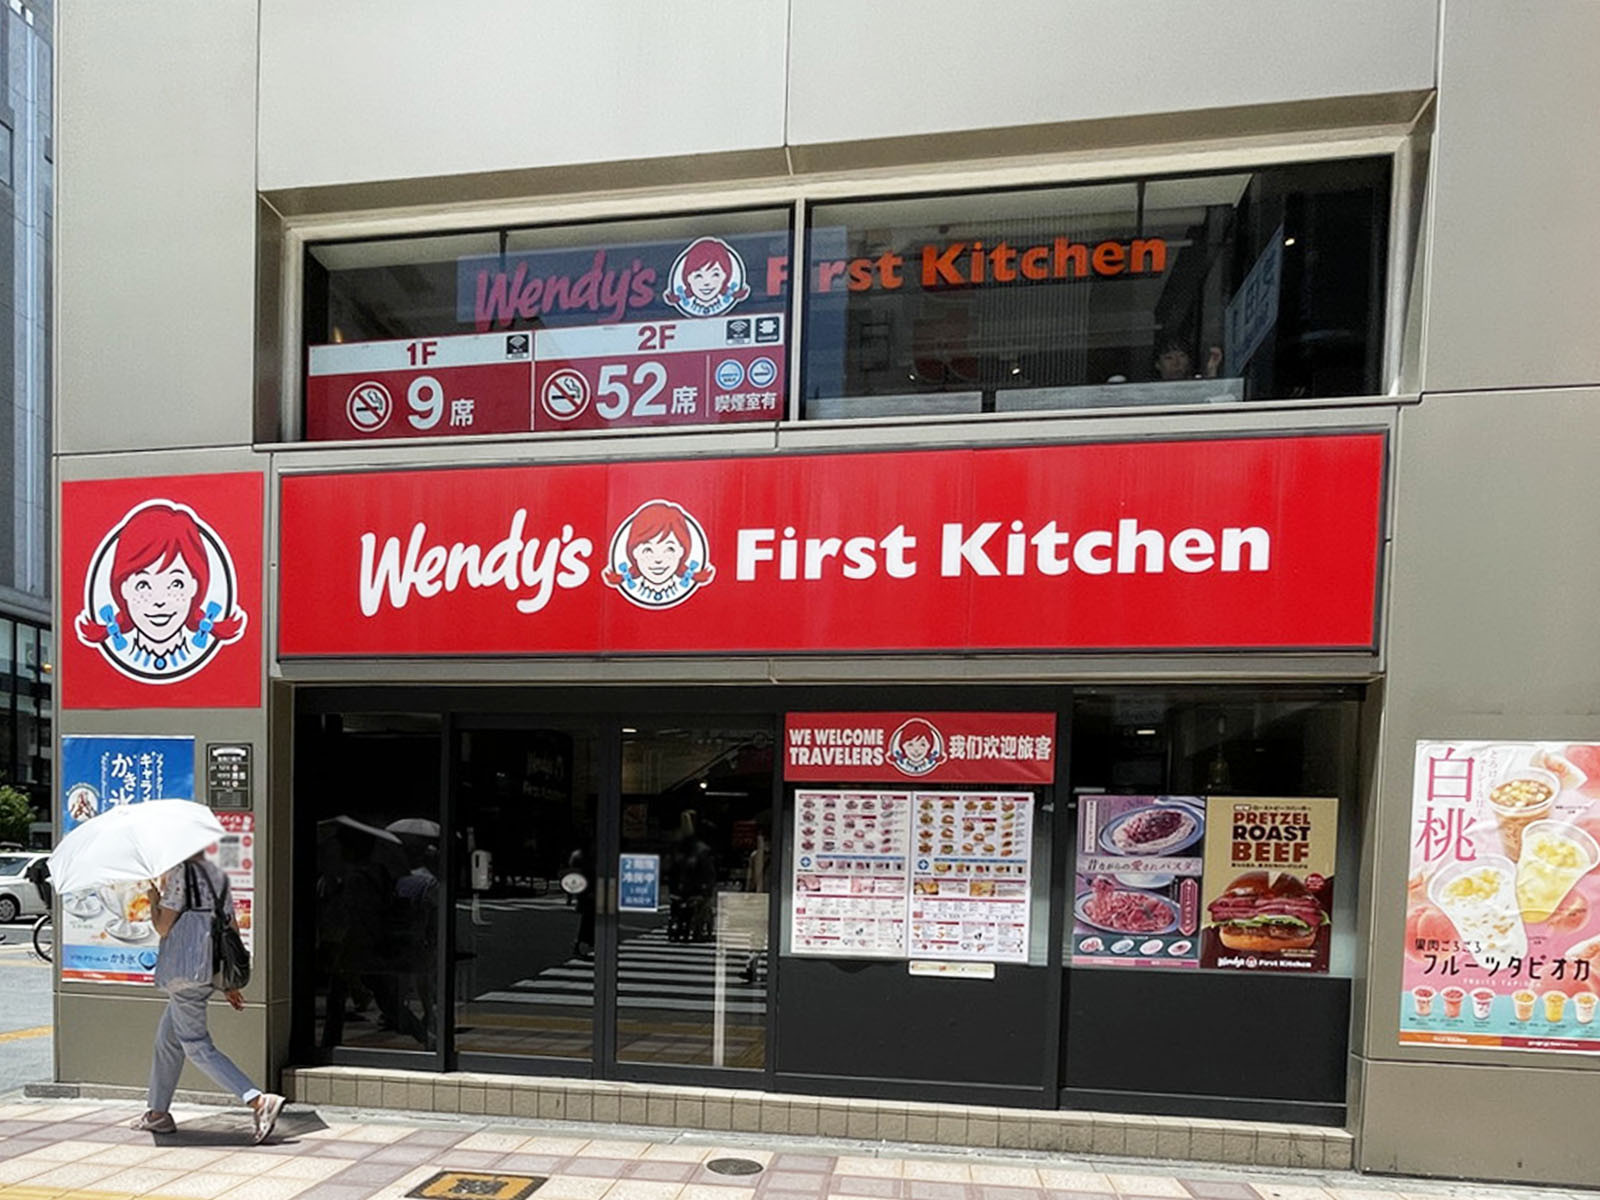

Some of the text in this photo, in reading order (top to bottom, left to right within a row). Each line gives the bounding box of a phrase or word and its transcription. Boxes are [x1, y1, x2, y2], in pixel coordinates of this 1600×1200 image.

[474, 236, 1167, 332] Wendy's Frst Kitchen
[638, 324, 676, 350] 2F
[406, 341, 437, 366] 1F
[359, 508, 1271, 617] Wendy's First Kitchen
[789, 728, 884, 746] WE WELCOME
[948, 735, 1052, 761] 我们欢迎旅客
[789, 746, 884, 766] TRAVELERS
[1415, 747, 1477, 862] 白桃
[1233, 812, 1311, 825] PRETZEL
[1232, 825, 1311, 841] ROAST
[1231, 842, 1309, 863] BEEF
[1415, 938, 1482, 954] 果肉ごろごろ
[1424, 954, 1590, 981] フルーツタピオカ
